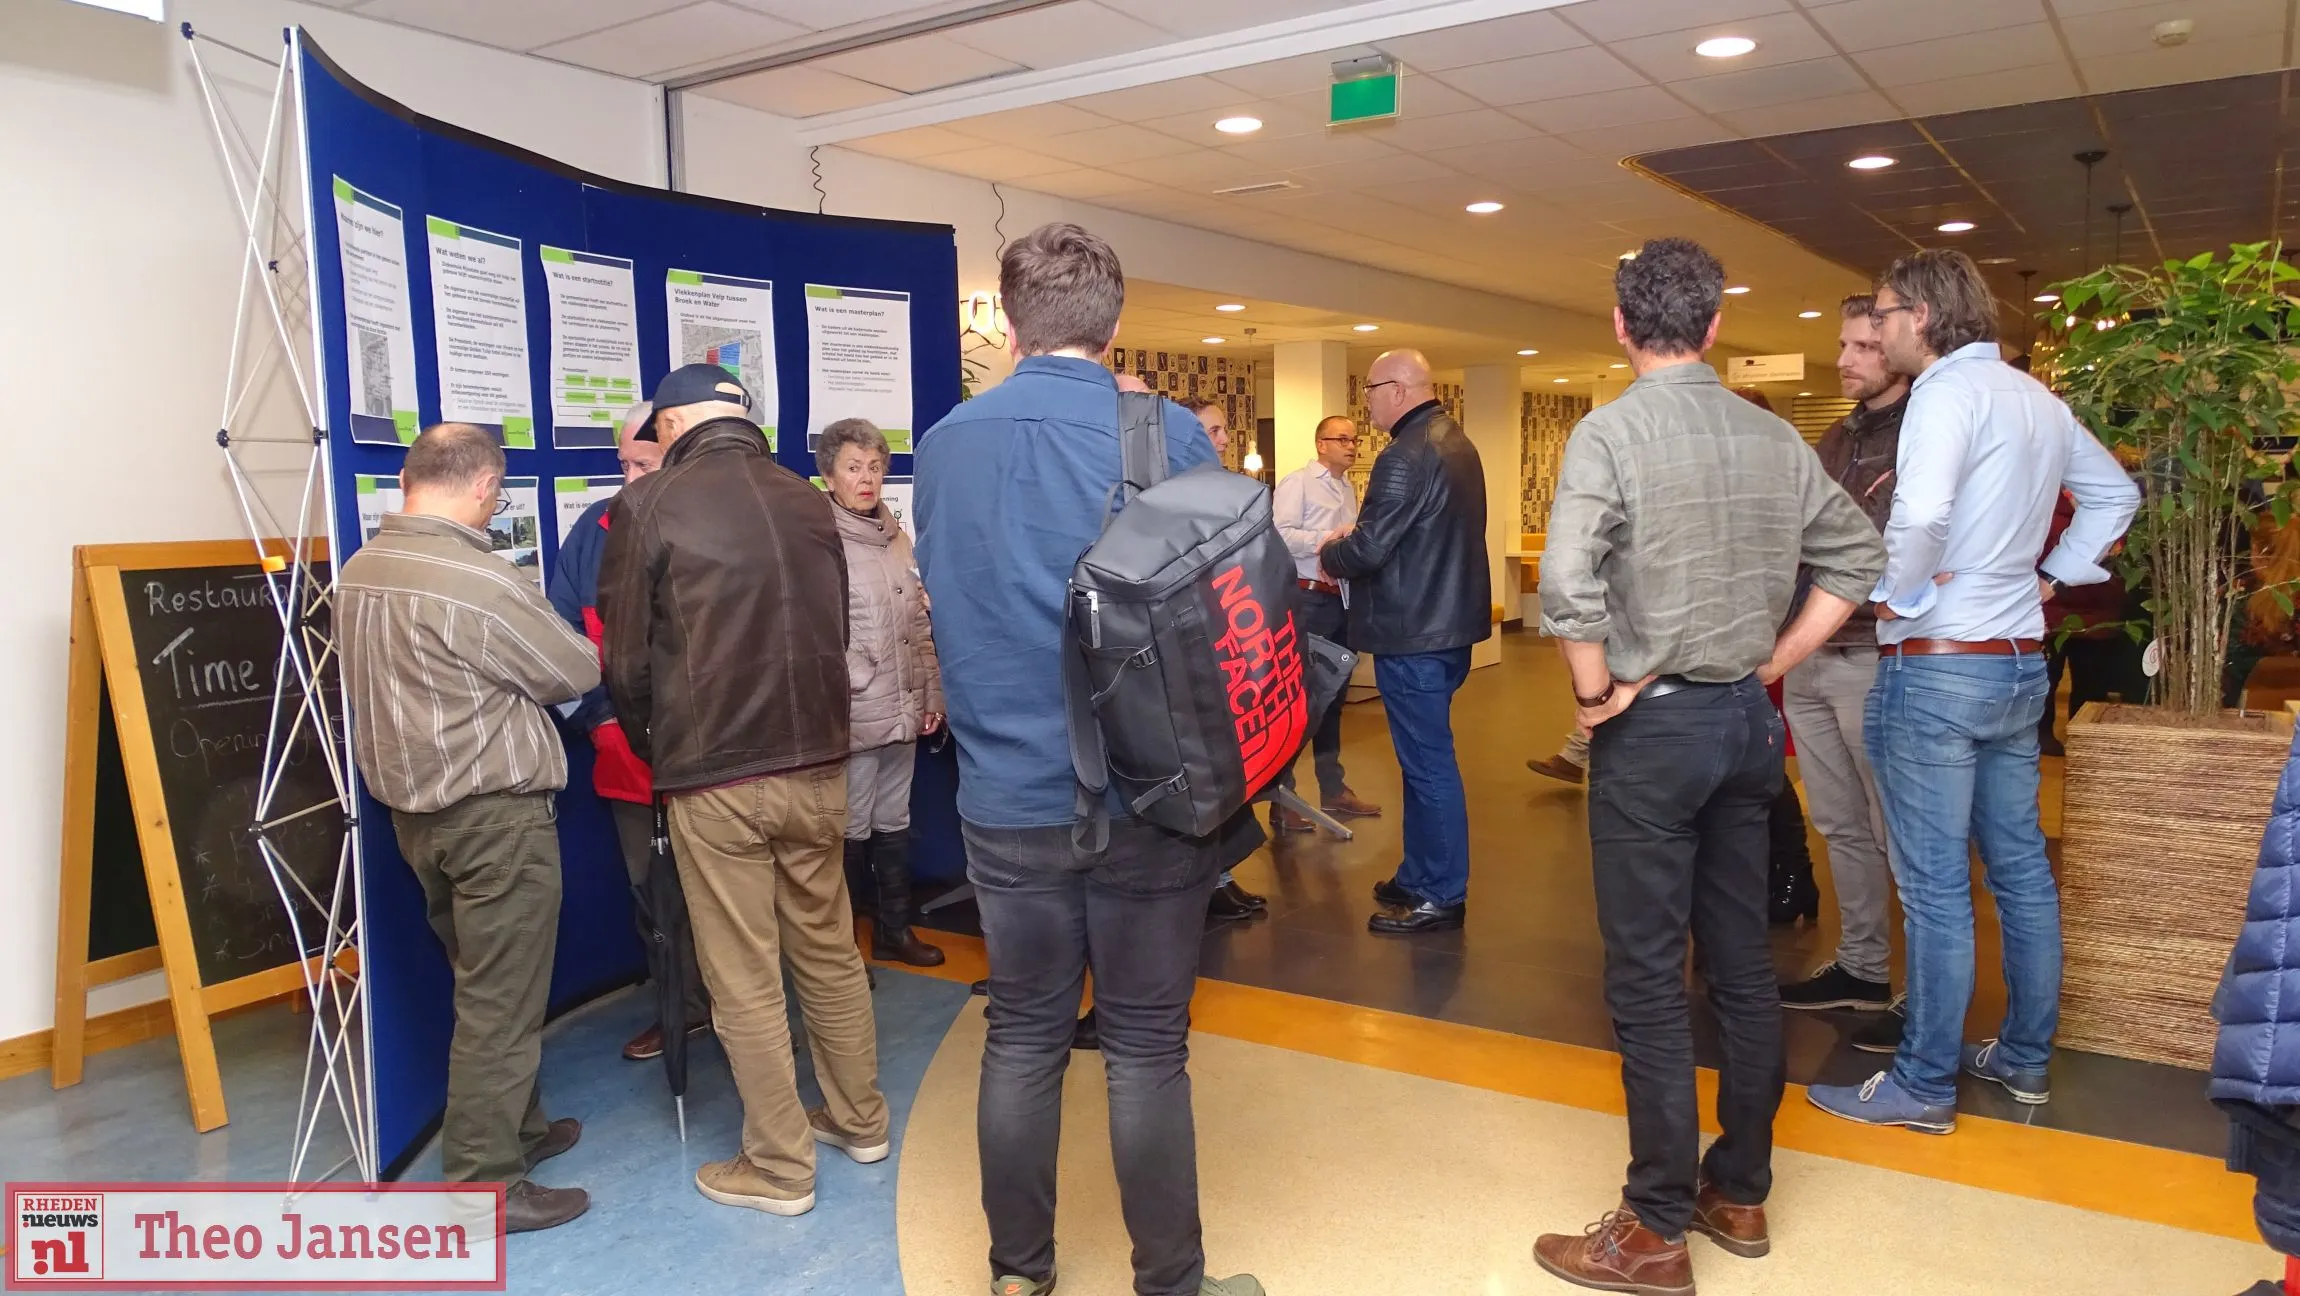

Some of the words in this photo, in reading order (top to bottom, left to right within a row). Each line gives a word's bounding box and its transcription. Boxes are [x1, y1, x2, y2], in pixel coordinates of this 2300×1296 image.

[435, 247, 448, 256] Wat
[449, 250, 466, 260] weten
[477, 256, 486, 264] al?
[552, 271, 565, 280] Wat
[674, 288, 711, 299] Vlekkenplan
[712, 292, 725, 301] Velp
[674, 297, 693, 305] Broek
[703, 300, 720, 308] Water
[848, 308, 885, 318] masterplan?
[1211, 564, 1290, 724] NORTH
[152, 627, 261, 699] Time
[1274, 608, 1304, 701] THE
[1214, 627, 1267, 743] FACE
